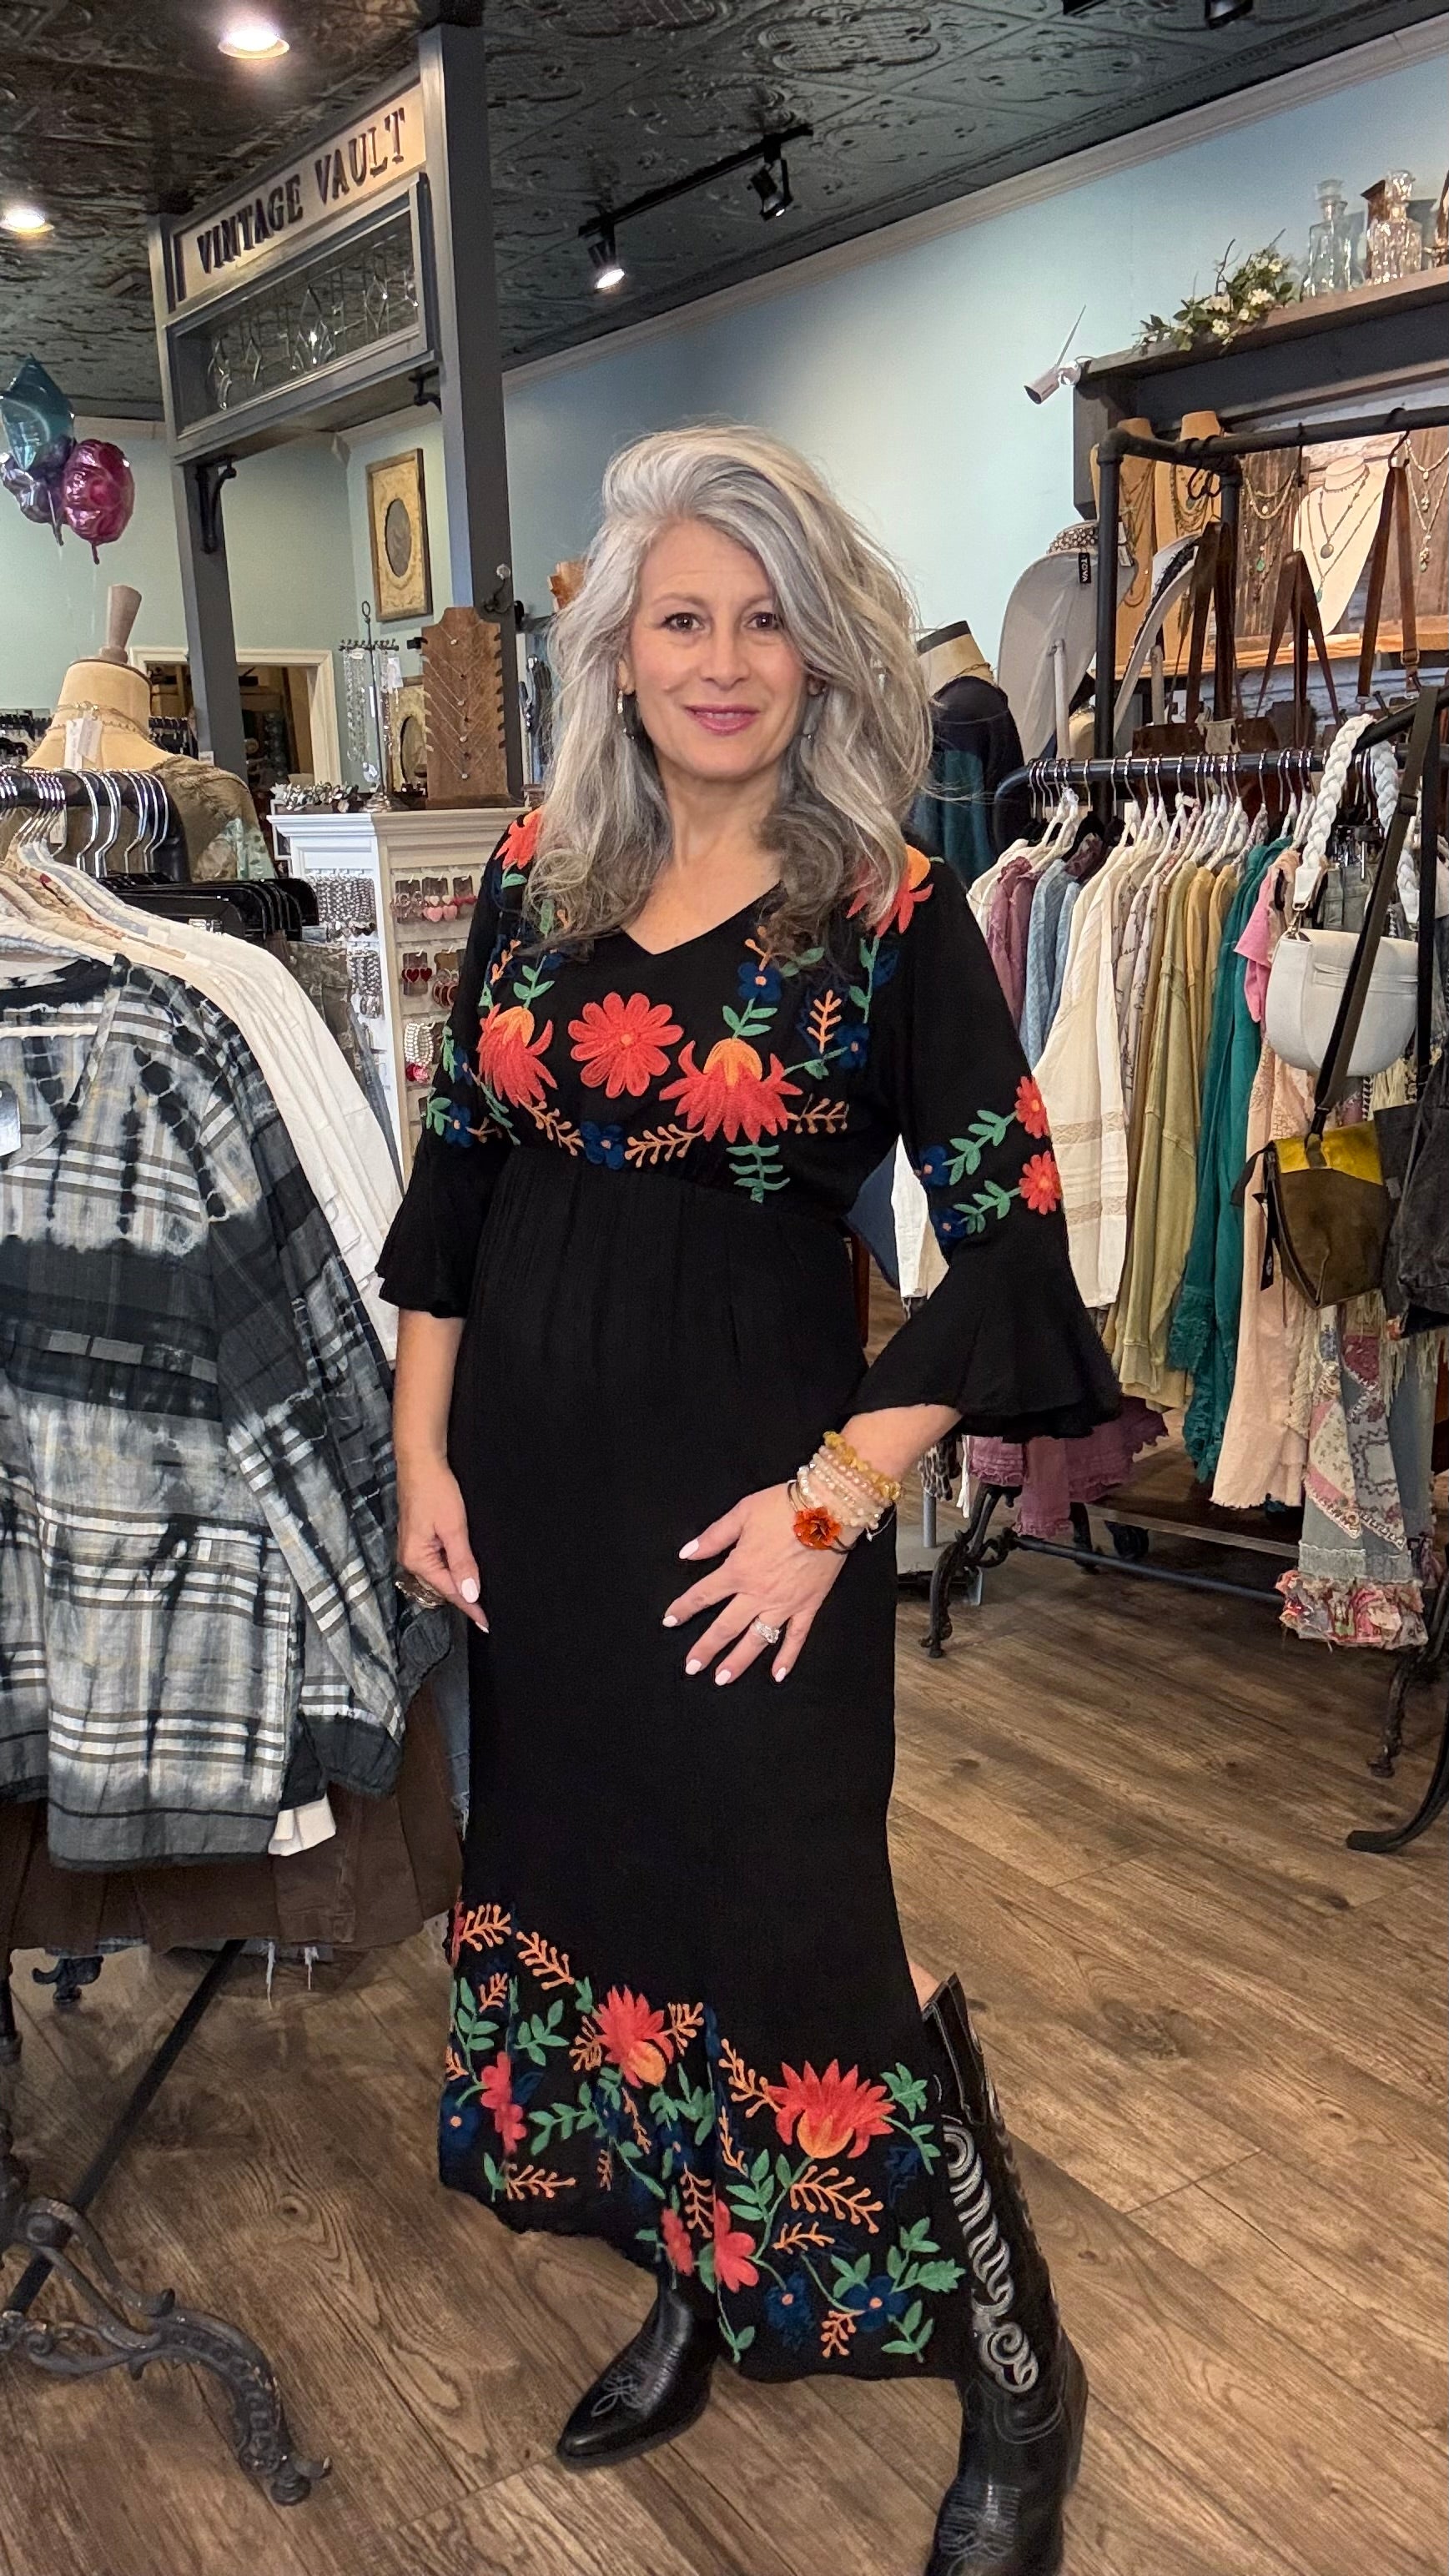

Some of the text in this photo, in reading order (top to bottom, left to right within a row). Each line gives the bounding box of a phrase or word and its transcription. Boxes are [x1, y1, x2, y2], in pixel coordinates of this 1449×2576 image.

[197, 108, 405, 274] VINTAGE VAULT
[1080, 558, 1089, 582] TOVA
